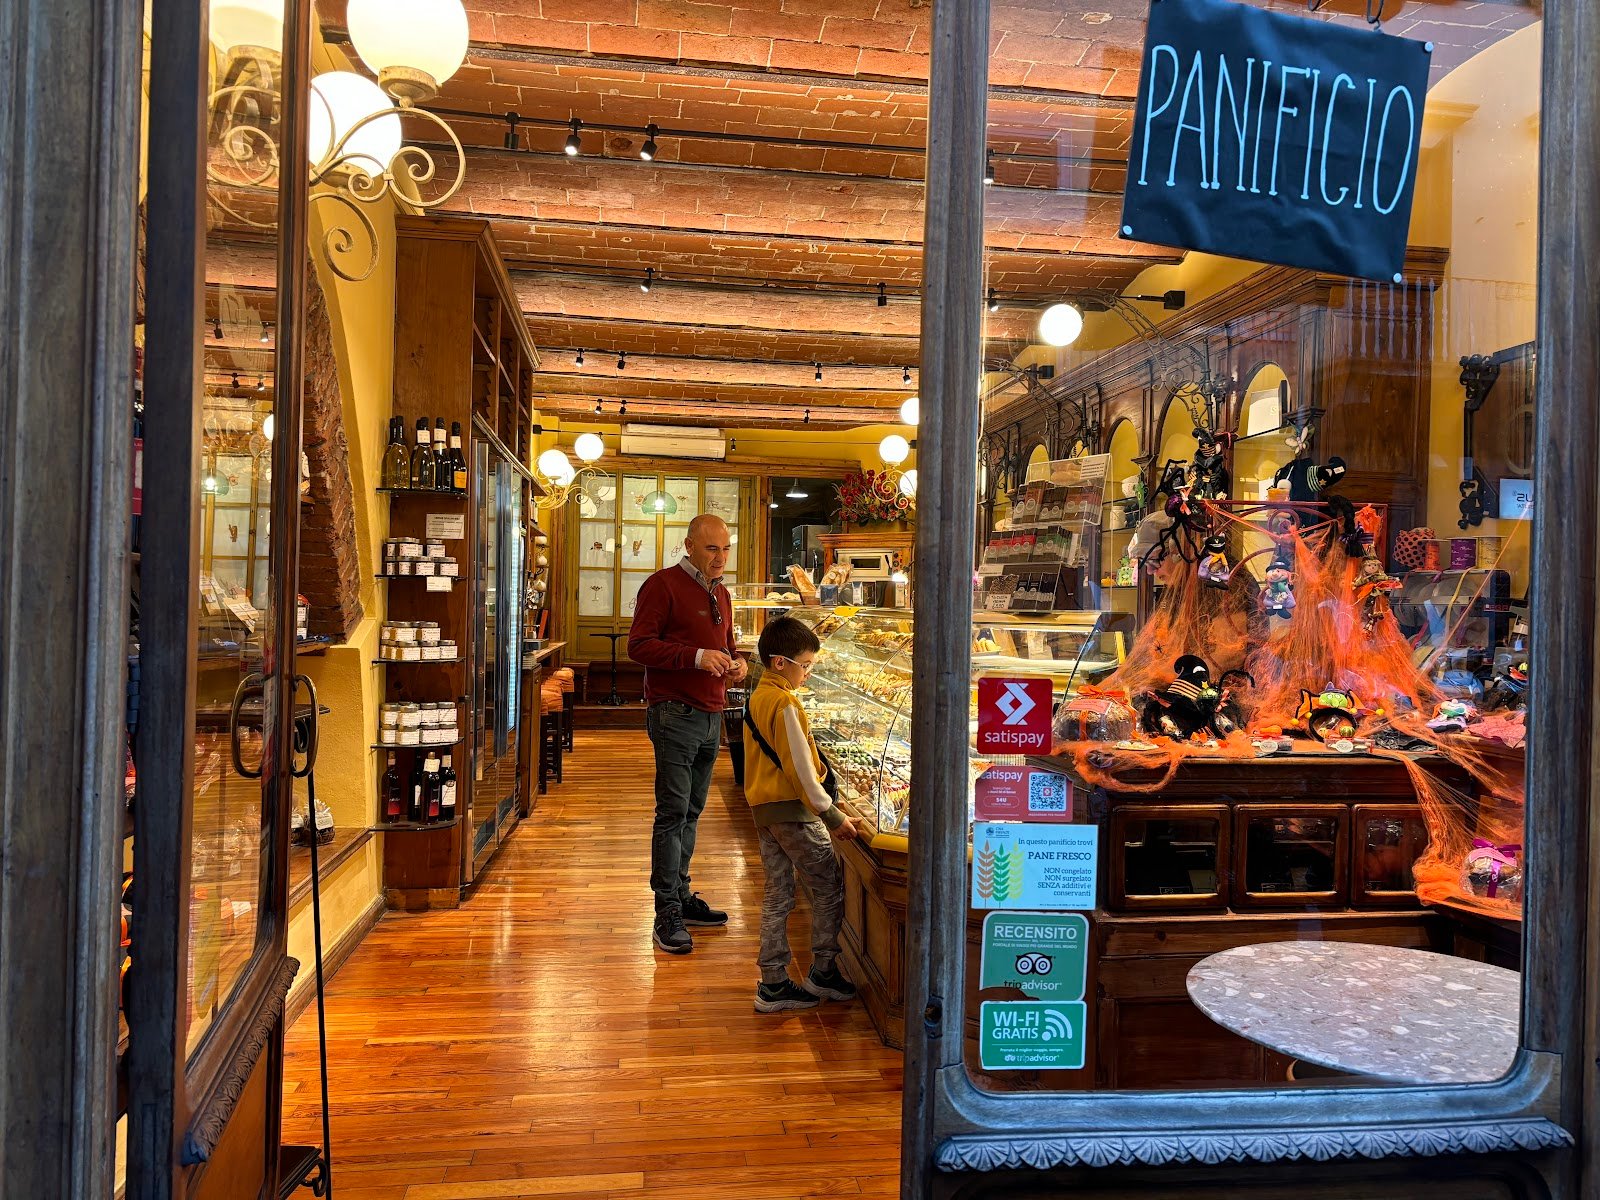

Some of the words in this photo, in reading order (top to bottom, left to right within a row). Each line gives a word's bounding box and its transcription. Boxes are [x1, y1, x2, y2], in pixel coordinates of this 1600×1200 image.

[1137, 43, 1414, 215] PANIFICIO
[984, 730, 1045, 748] satispay
[1025, 838, 1047, 846] questo
[1048, 838, 1077, 846] panificio
[1077, 838, 1093, 846] trovi
[1028, 851, 1055, 860] PANE
[1056, 852, 1092, 861] FRESCO
[1061, 867, 1092, 876] congelato
[1044, 874, 1061, 882] NON
[1062, 875, 1092, 883] surgelato
[1053, 889, 1091, 897] conservanti
[993, 925, 1077, 940] RECENSITO
[1003, 979, 1059, 991] tripadvisor
[992, 1011, 1040, 1027] WI-FI
[992, 1027, 1039, 1040] GRATIS
[1016, 1053, 1058, 1063] tripadvisor
